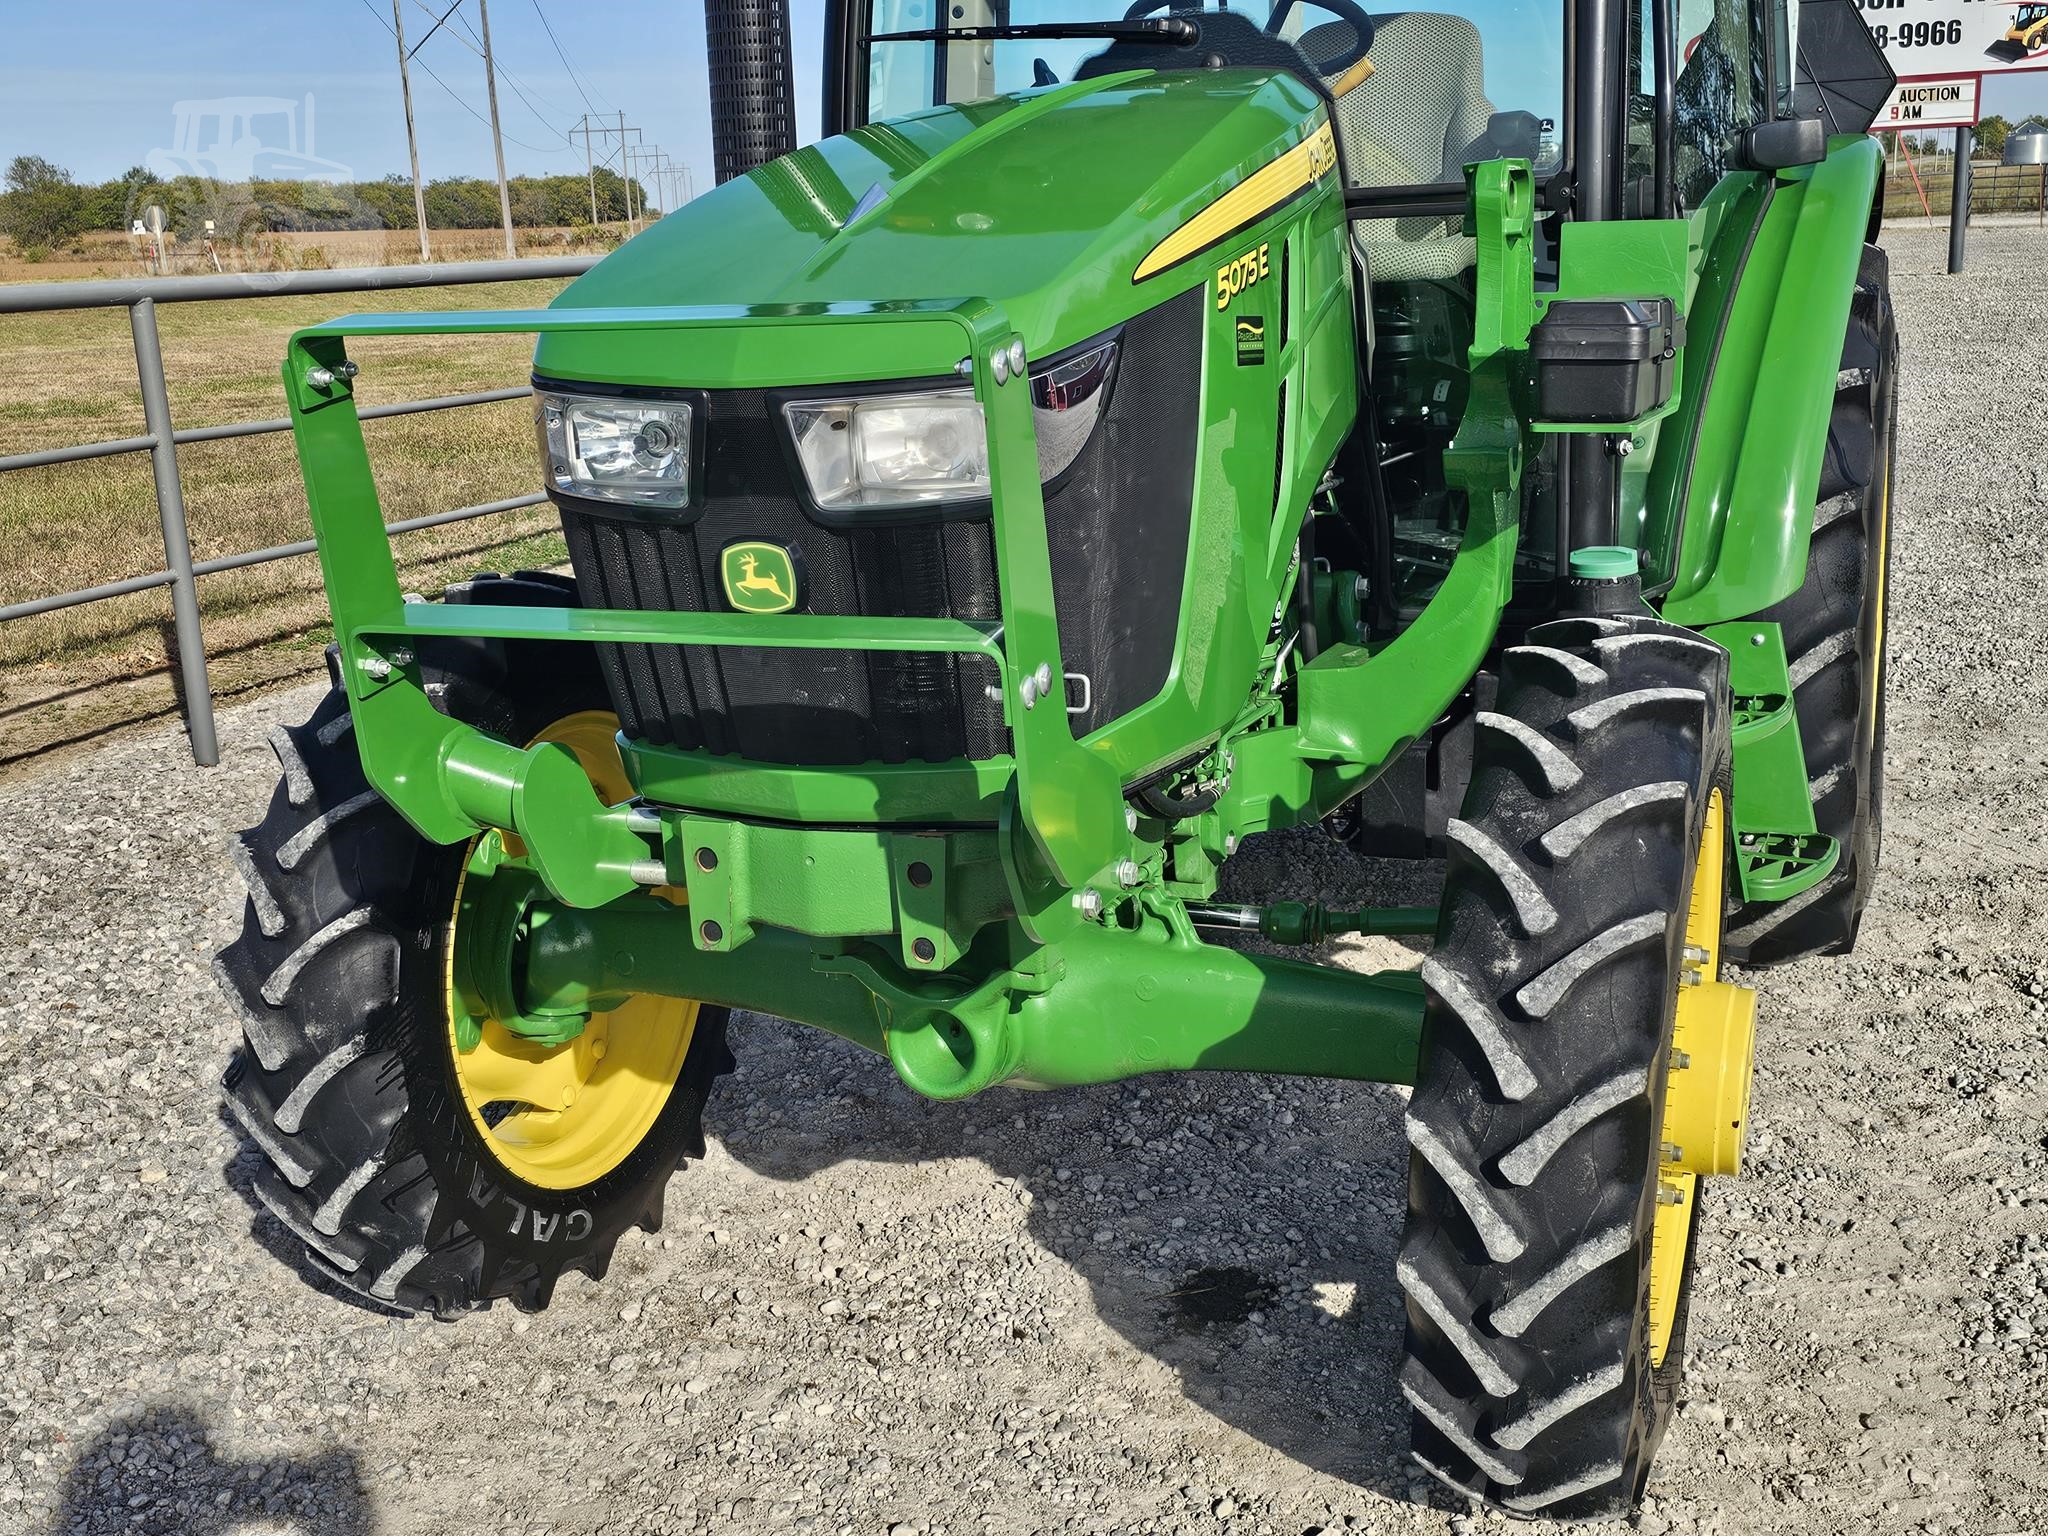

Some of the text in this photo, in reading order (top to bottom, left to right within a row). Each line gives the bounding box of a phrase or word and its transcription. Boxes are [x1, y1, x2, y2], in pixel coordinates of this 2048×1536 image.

[1868, 19, 1962, 49] 8-9966
[1899, 86, 1960, 103] AUCTION
[1890, 104, 1922, 119] 9 AM
